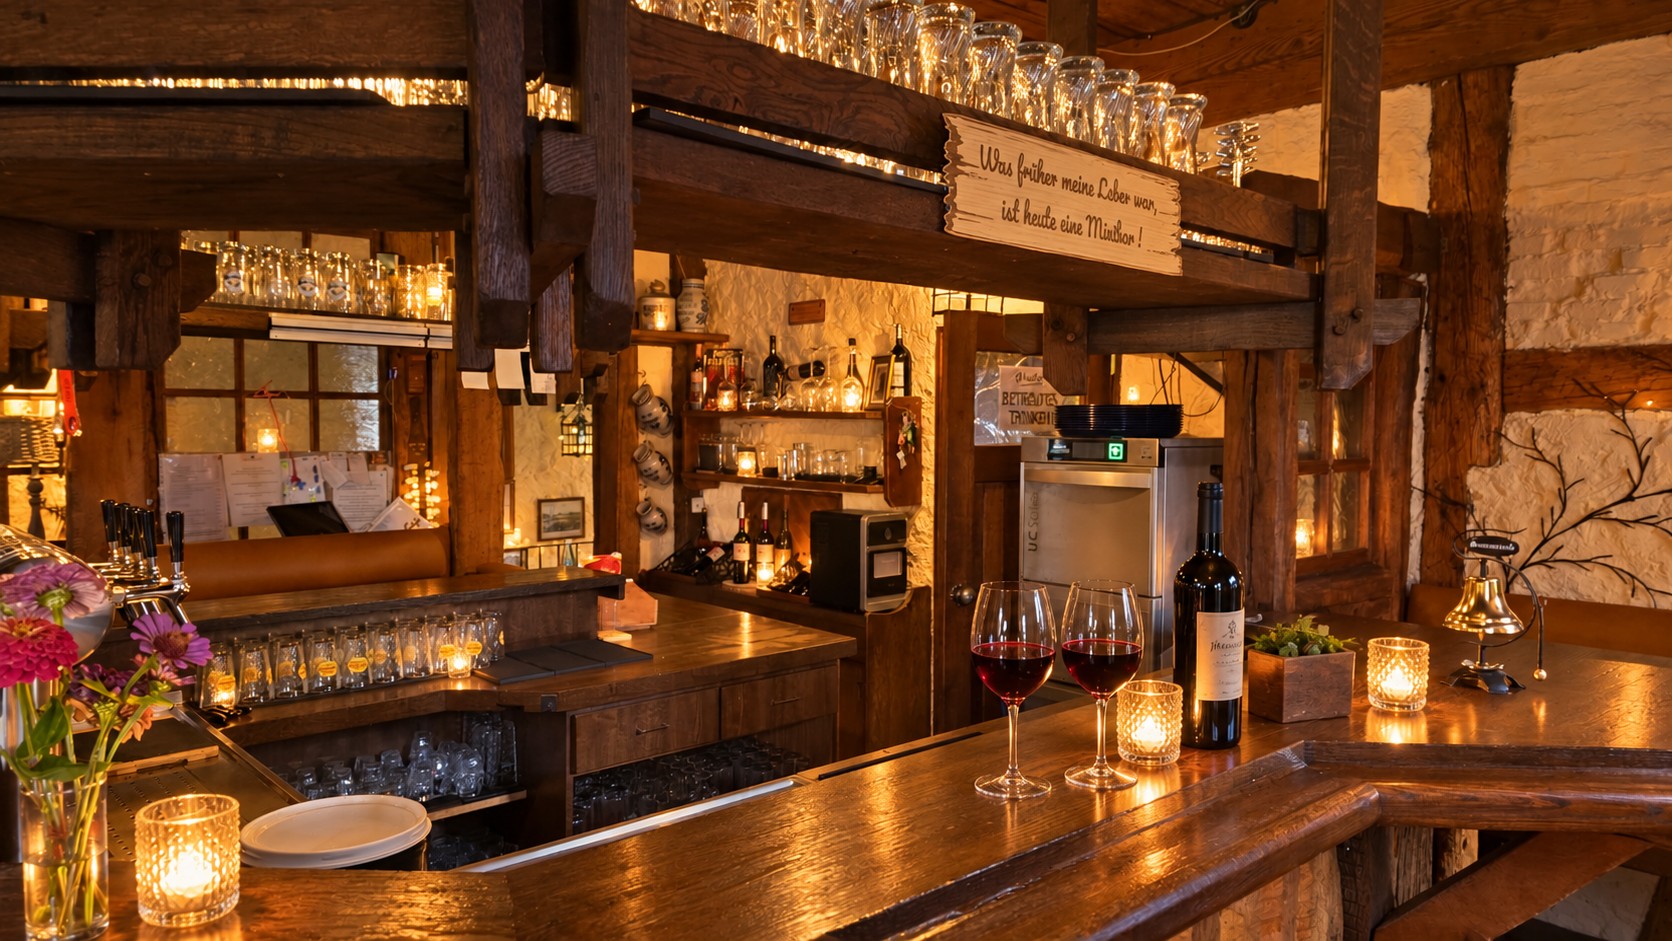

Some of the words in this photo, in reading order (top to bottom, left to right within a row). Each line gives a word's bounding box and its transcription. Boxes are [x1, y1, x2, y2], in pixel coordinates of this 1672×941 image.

[980, 144, 1013, 177] Was
[1017, 152, 1058, 188] früher
[1061, 175, 1095, 197] meine
[1134, 194, 1158, 216] war,
[1001, 199, 1020, 223] ist
[1023, 198, 1057, 231] heute
[1060, 215, 1083, 236] eine
